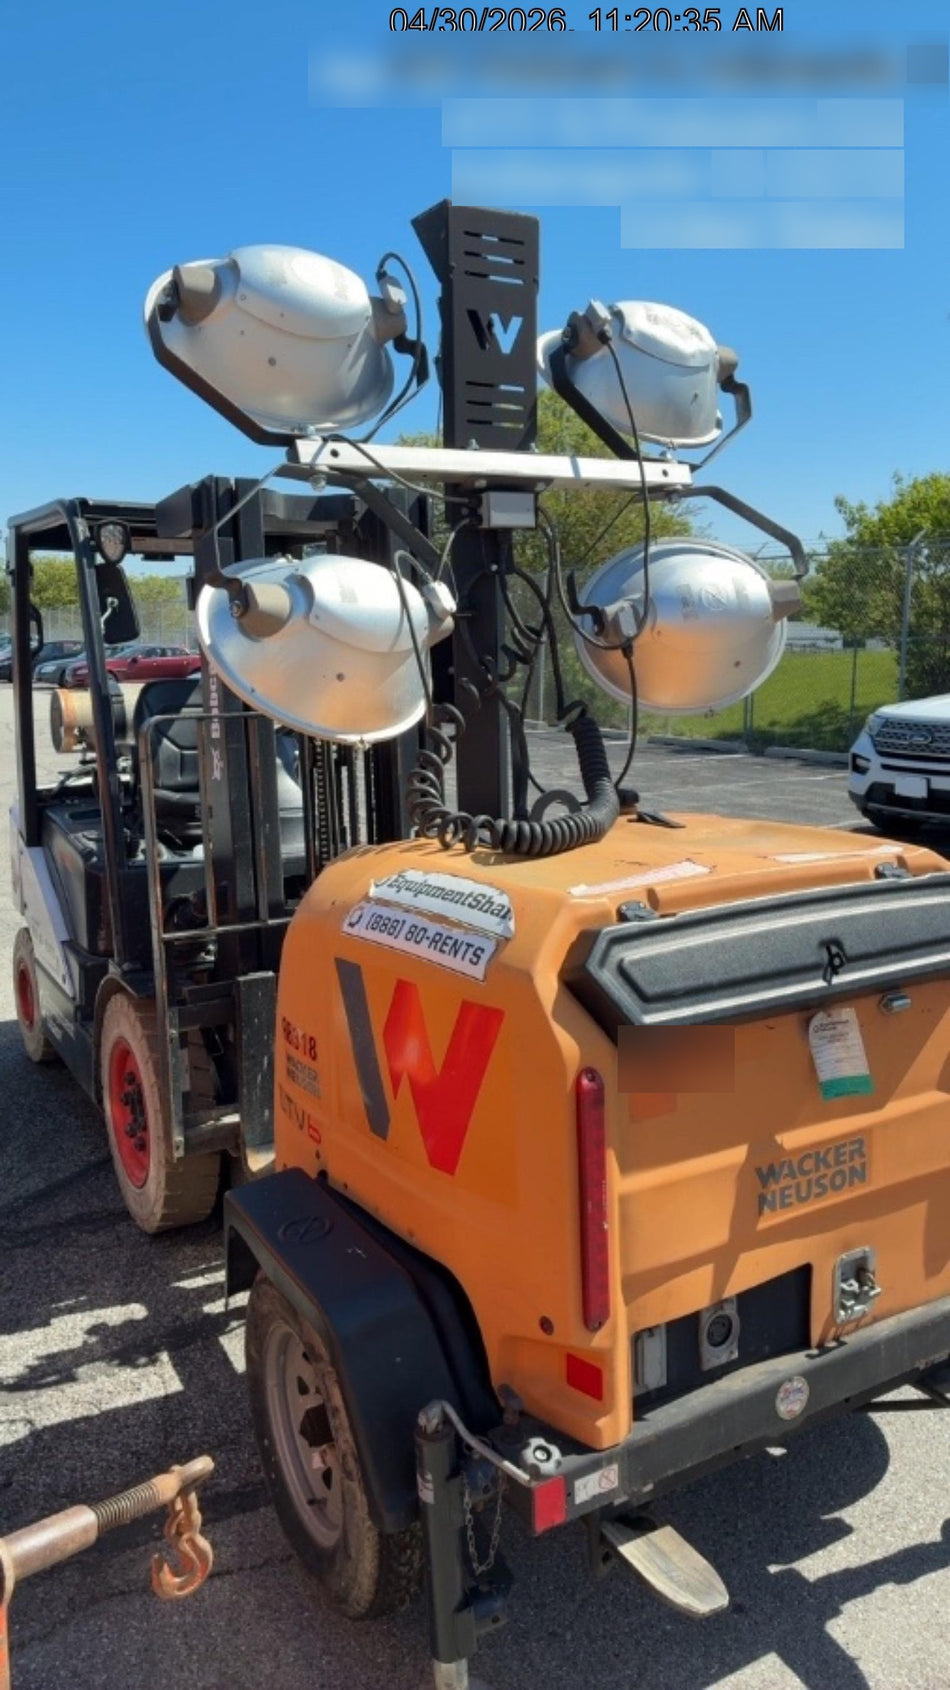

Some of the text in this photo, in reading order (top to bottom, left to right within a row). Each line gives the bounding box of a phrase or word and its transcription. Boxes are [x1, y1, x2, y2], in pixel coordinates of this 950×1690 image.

[365, 912, 485, 966] (888) 80-RENTS
[755, 1138, 867, 1189] WACKER
[757, 1161, 867, 1217] NEUSON
